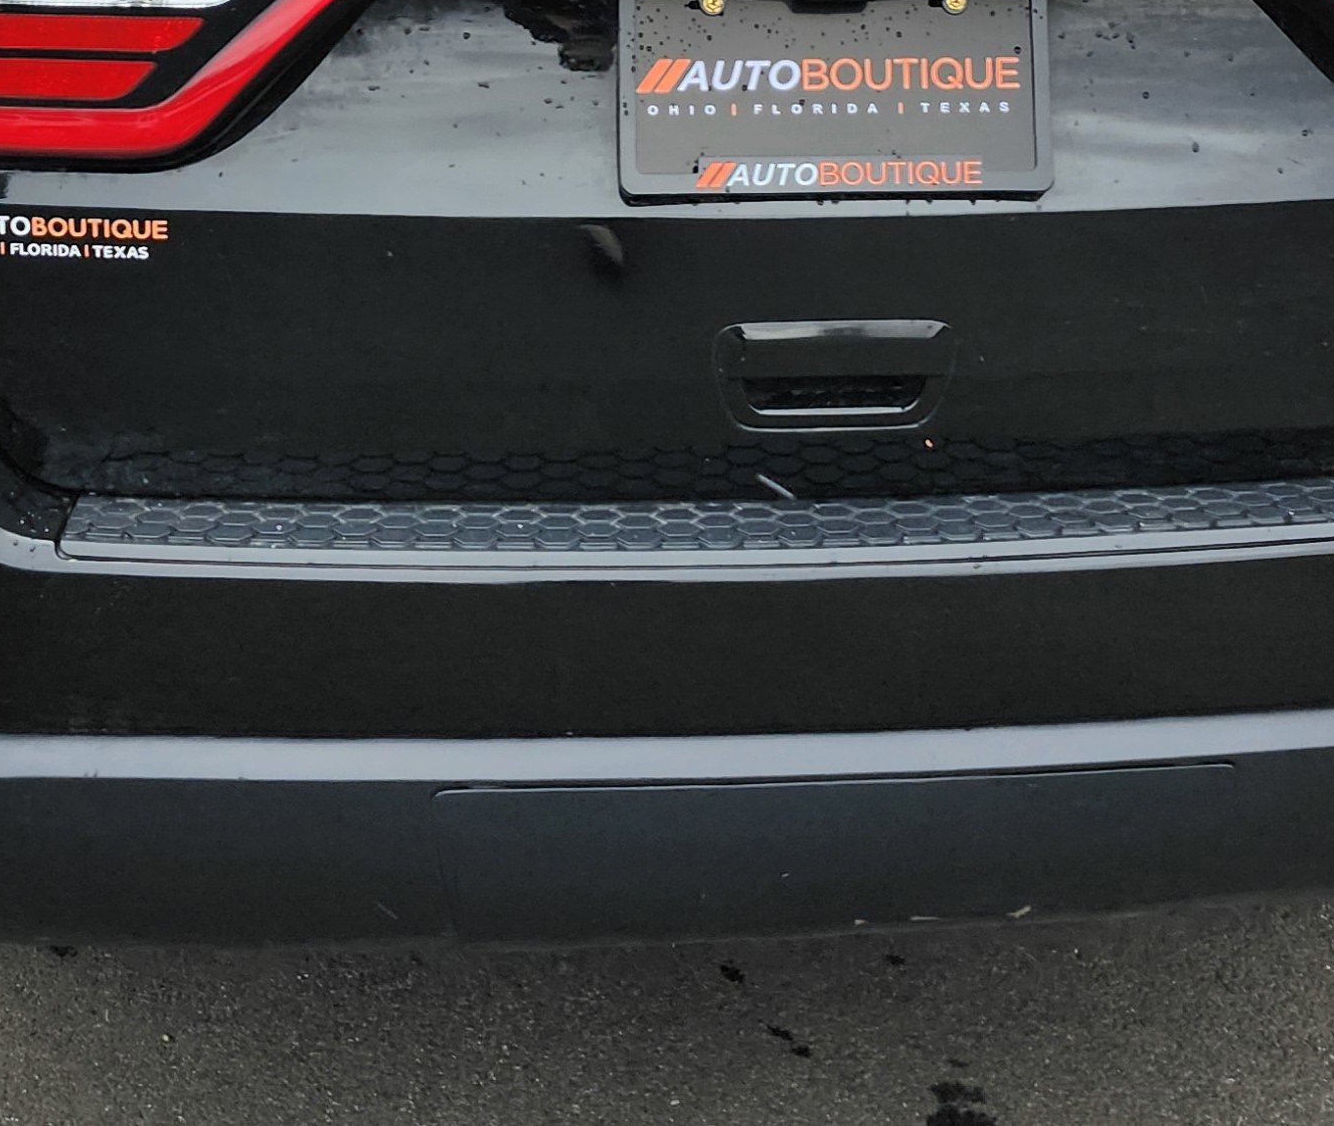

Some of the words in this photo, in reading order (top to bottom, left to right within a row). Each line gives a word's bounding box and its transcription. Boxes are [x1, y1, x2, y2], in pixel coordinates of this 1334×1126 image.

[646, 103, 718, 116] OHIO
[753, 102, 879, 116] FLORIDA
[920, 100, 1011, 114] TEXAS
[9, 242, 82, 258] FLORIDA
[91, 245, 150, 260] TEXAS
